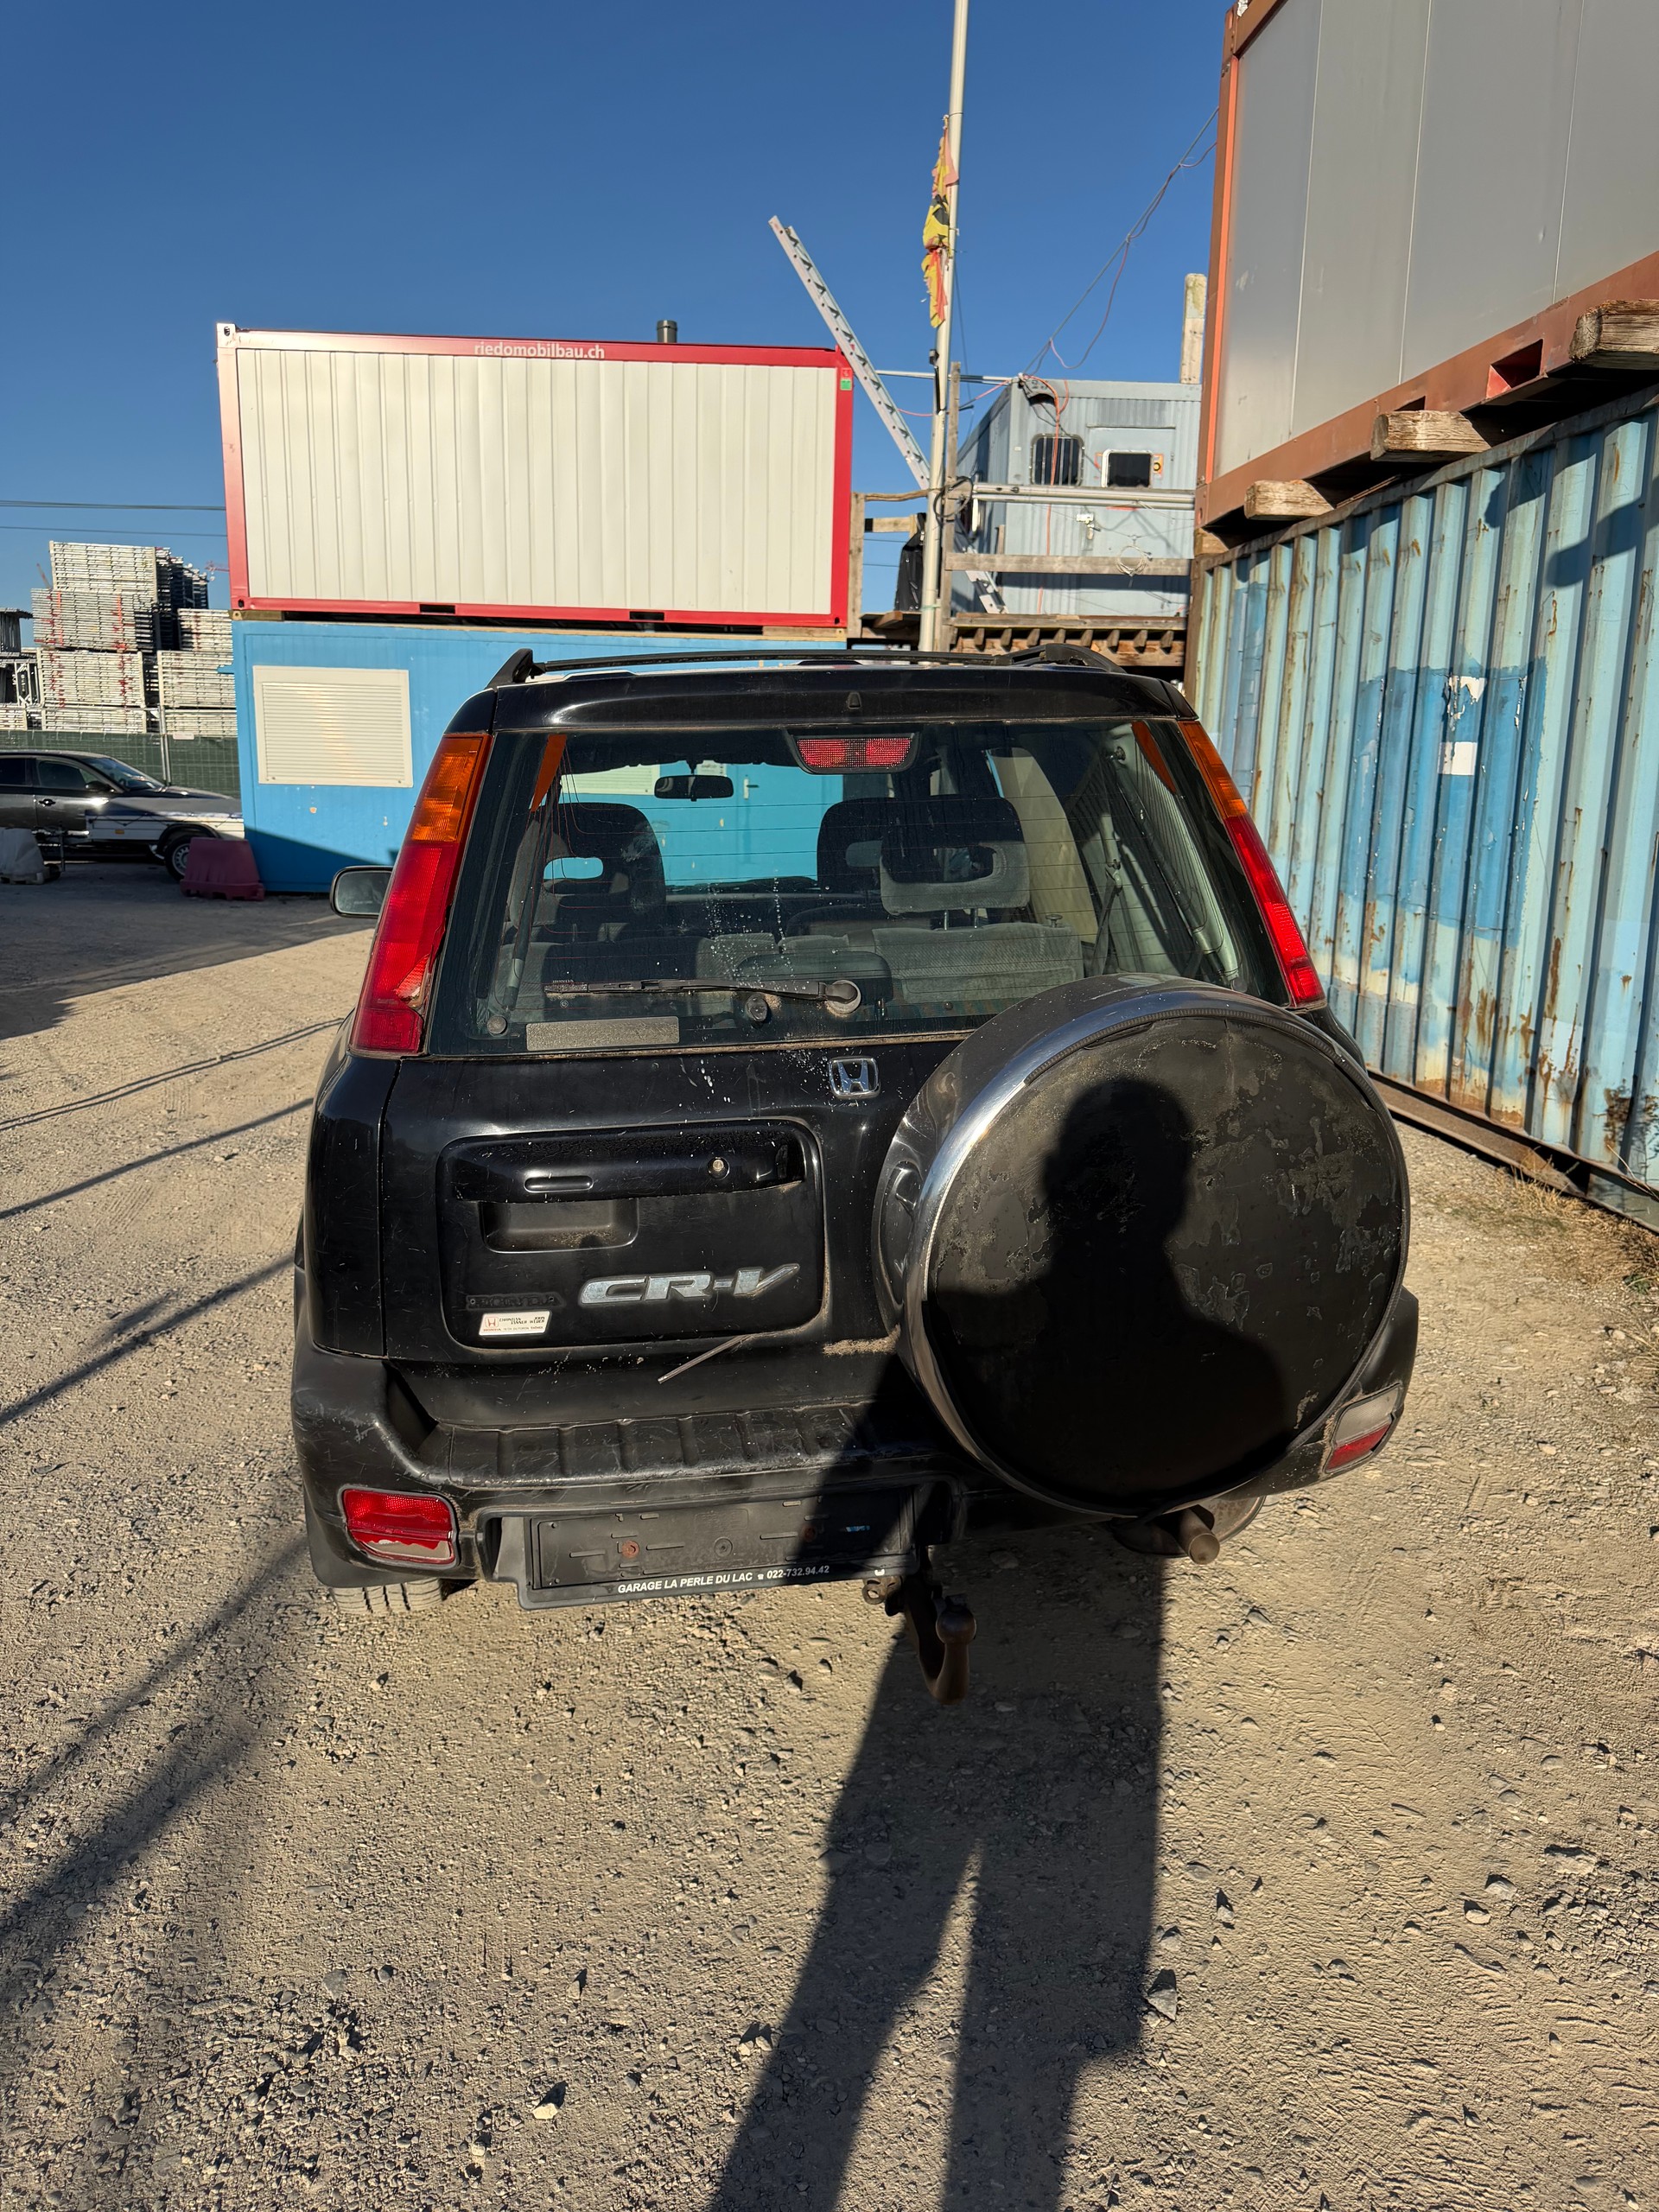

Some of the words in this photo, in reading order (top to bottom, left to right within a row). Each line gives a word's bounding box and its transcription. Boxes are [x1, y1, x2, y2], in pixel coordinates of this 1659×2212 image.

[475, 341, 605, 359] riedomobilbau.ch
[581, 1264, 799, 1304] CR-V
[617, 1580, 663, 1594] GARAGE
[664, 1580, 677, 1589] LA
[679, 1575, 714, 1588] PERLE
[715, 1574, 731, 1585] DU
[732, 1572, 753, 1583] LAC
[766, 1565, 830, 1580] 022-732.94.42
